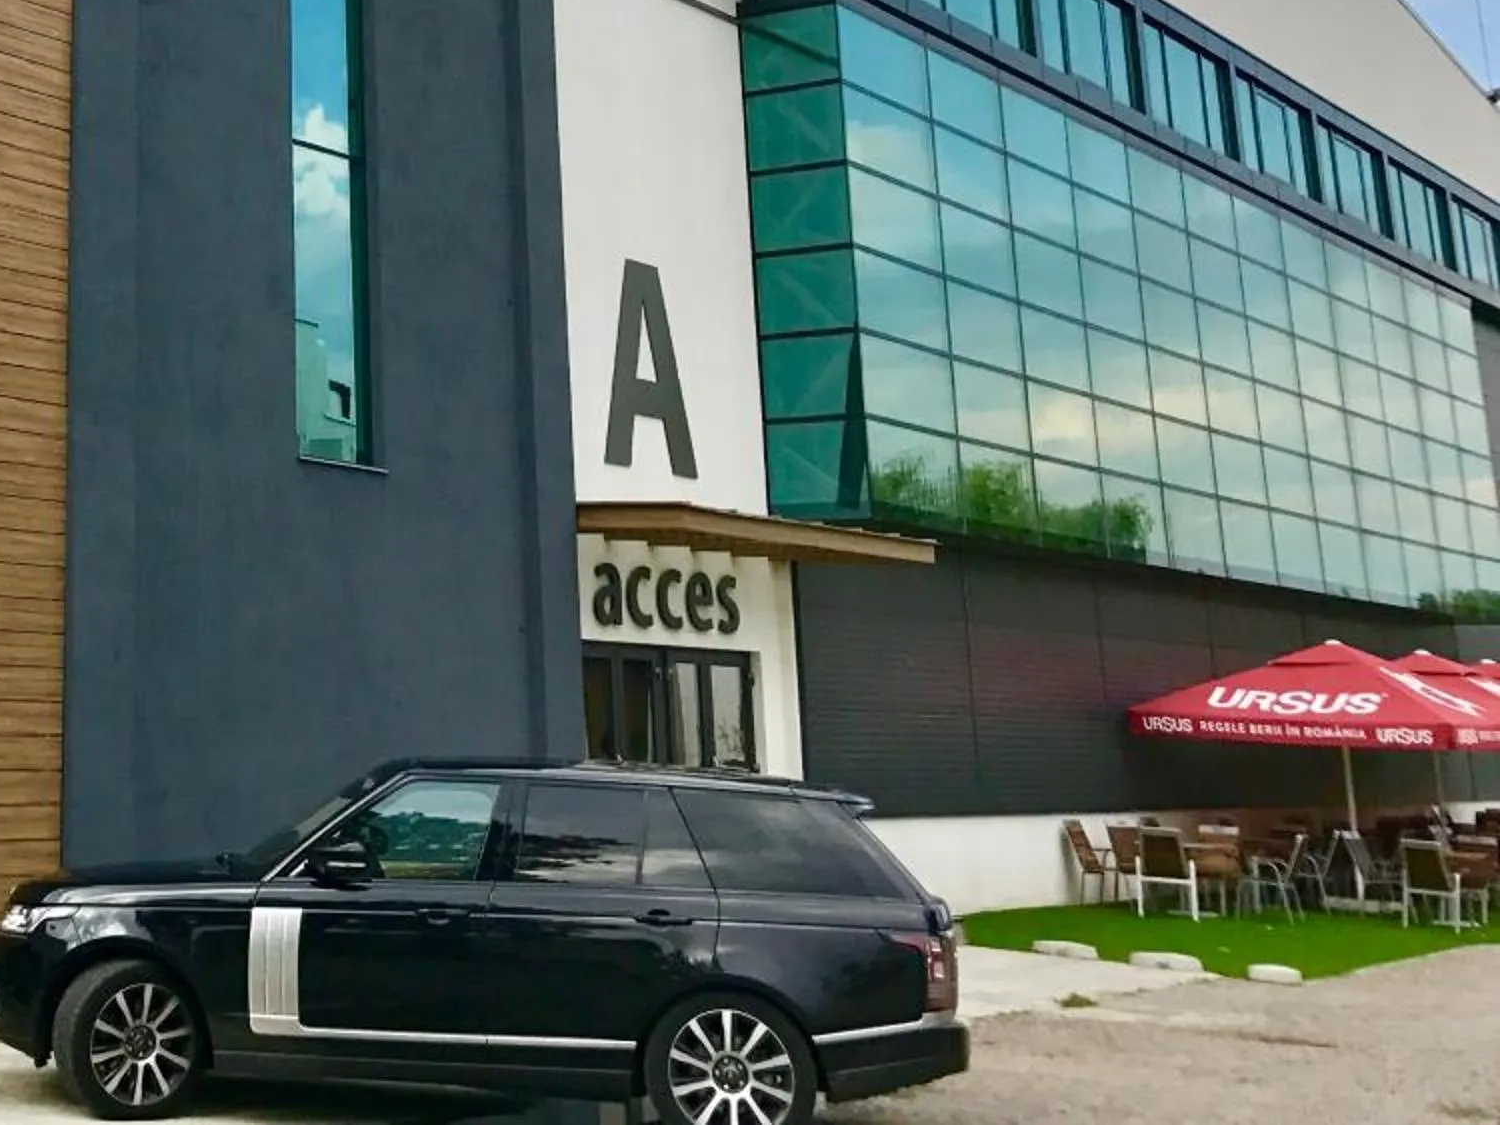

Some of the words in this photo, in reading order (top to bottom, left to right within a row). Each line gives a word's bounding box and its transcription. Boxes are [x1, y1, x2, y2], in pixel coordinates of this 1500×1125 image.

[604, 259, 699, 480] A
[593, 562, 741, 635] acces
[1207, 686, 1382, 715] URSUS
[1142, 716, 1193, 733] URSUS
[1199, 720, 1246, 734] REGELE
[1375, 727, 1434, 745] URSUS
